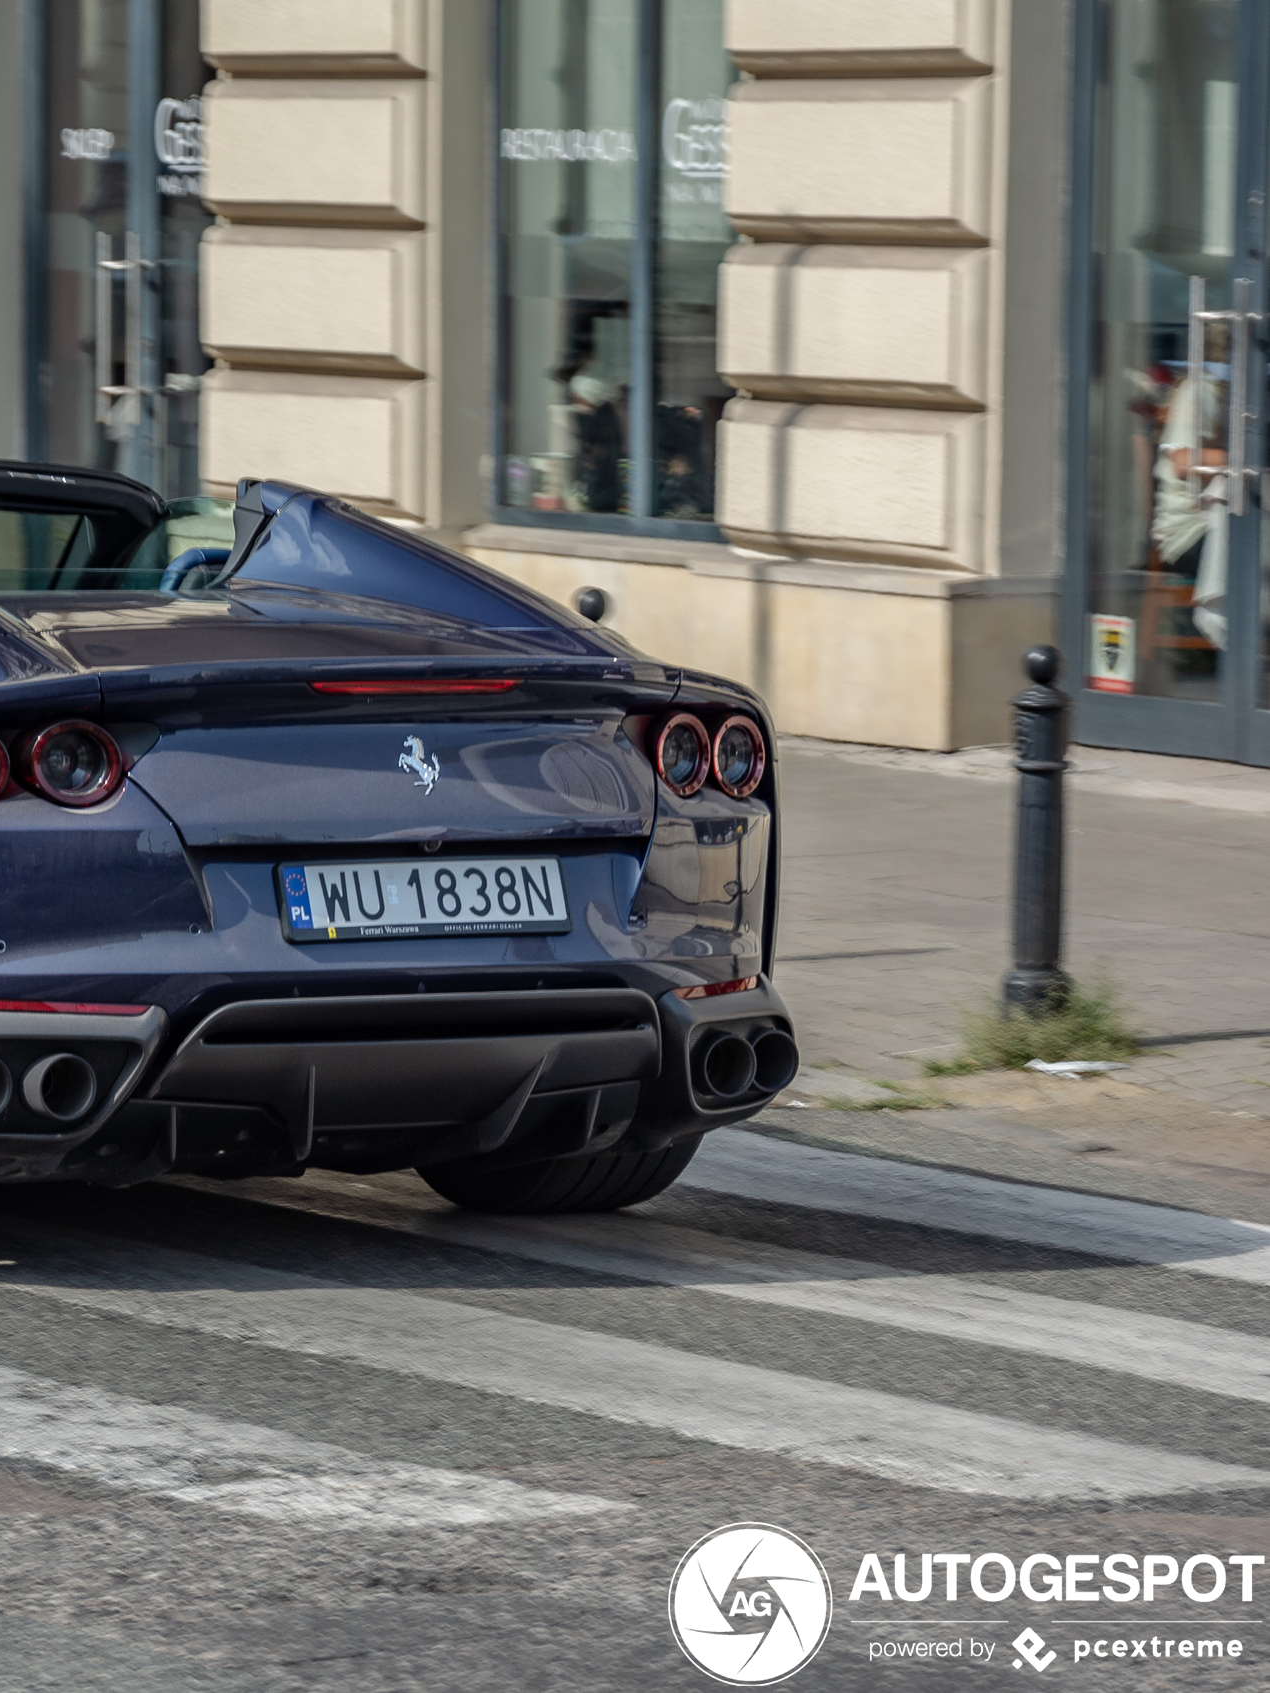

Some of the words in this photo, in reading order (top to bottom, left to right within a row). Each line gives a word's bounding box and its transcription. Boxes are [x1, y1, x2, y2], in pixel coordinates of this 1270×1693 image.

[500, 128, 638, 161] RESTAURACJA
[318, 869, 385, 922] WU
[407, 865, 555, 919] 1838N
[291, 905, 309, 921] PL
[360, 926, 384, 936] Ferrari
[384, 924, 420, 935] Warszawa
[444, 924, 472, 932] OFFICIAL
[473, 923, 499, 931] FERRARI
[499, 922, 522, 930] DEALER
